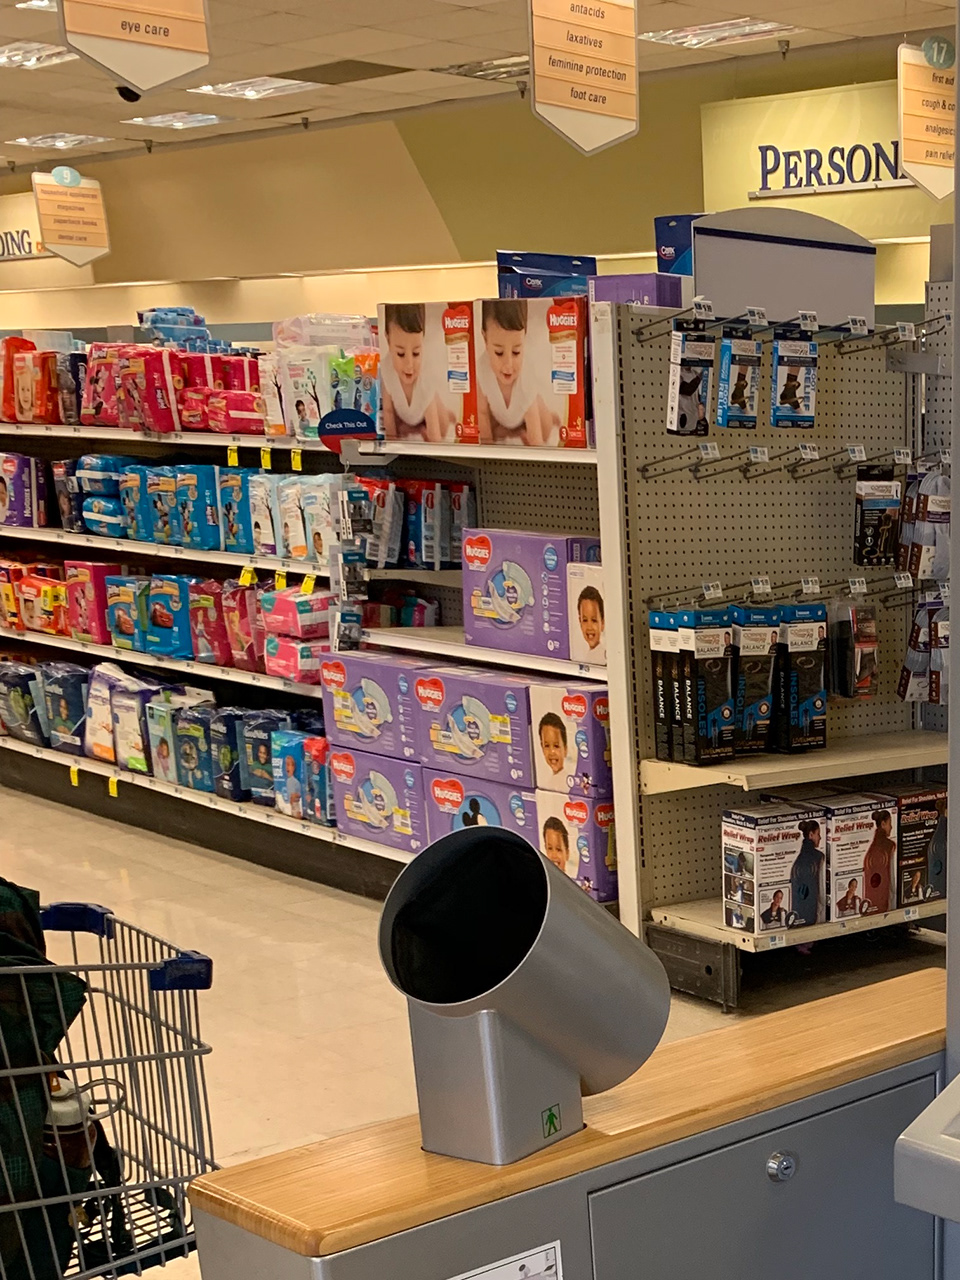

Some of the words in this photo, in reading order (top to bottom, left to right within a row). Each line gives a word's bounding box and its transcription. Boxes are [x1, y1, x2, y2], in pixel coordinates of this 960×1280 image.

[570, 3, 605, 19] antacids
[120, 20, 141, 34] eye
[144, 24, 170, 37] care
[566, 30, 603, 48] laxatives
[932, 42, 947, 63] 17
[548, 55, 584, 72] feminine
[585, 64, 627, 82] protection
[931, 72, 944, 84] first
[945, 75, 955, 85] aid
[570, 87, 587, 101] foot
[588, 93, 607, 104] care
[921, 97, 940, 110] cough
[941, 100, 947, 110] &
[925, 149, 938, 159] pain
[758, 140, 908, 191] PERSON
[62, 170, 71, 183] 9
[444, 316, 469, 329] HUGGIES
[550, 313, 578, 327] HUGGIES
[325, 422, 343, 430] Check
[561, 428, 567, 438] 3
[466, 544, 489, 558] HUGGIES
[657, 680, 665, 719] BALANCE
[673, 681, 681, 721] BALANCE
[735, 674, 746, 728] INSOLES
[790, 670, 798, 726] INSOLES
[698, 678, 707, 737] INSOLES
[434, 786, 462, 802] HUGGIES
[835, 824, 855, 834] Relief
[856, 821, 874, 830] Wrap
[723, 829, 738, 839] Relief
[739, 833, 754, 844] Wrap
[757, 832, 780, 843] Relief
[781, 831, 802, 840] Wrap
